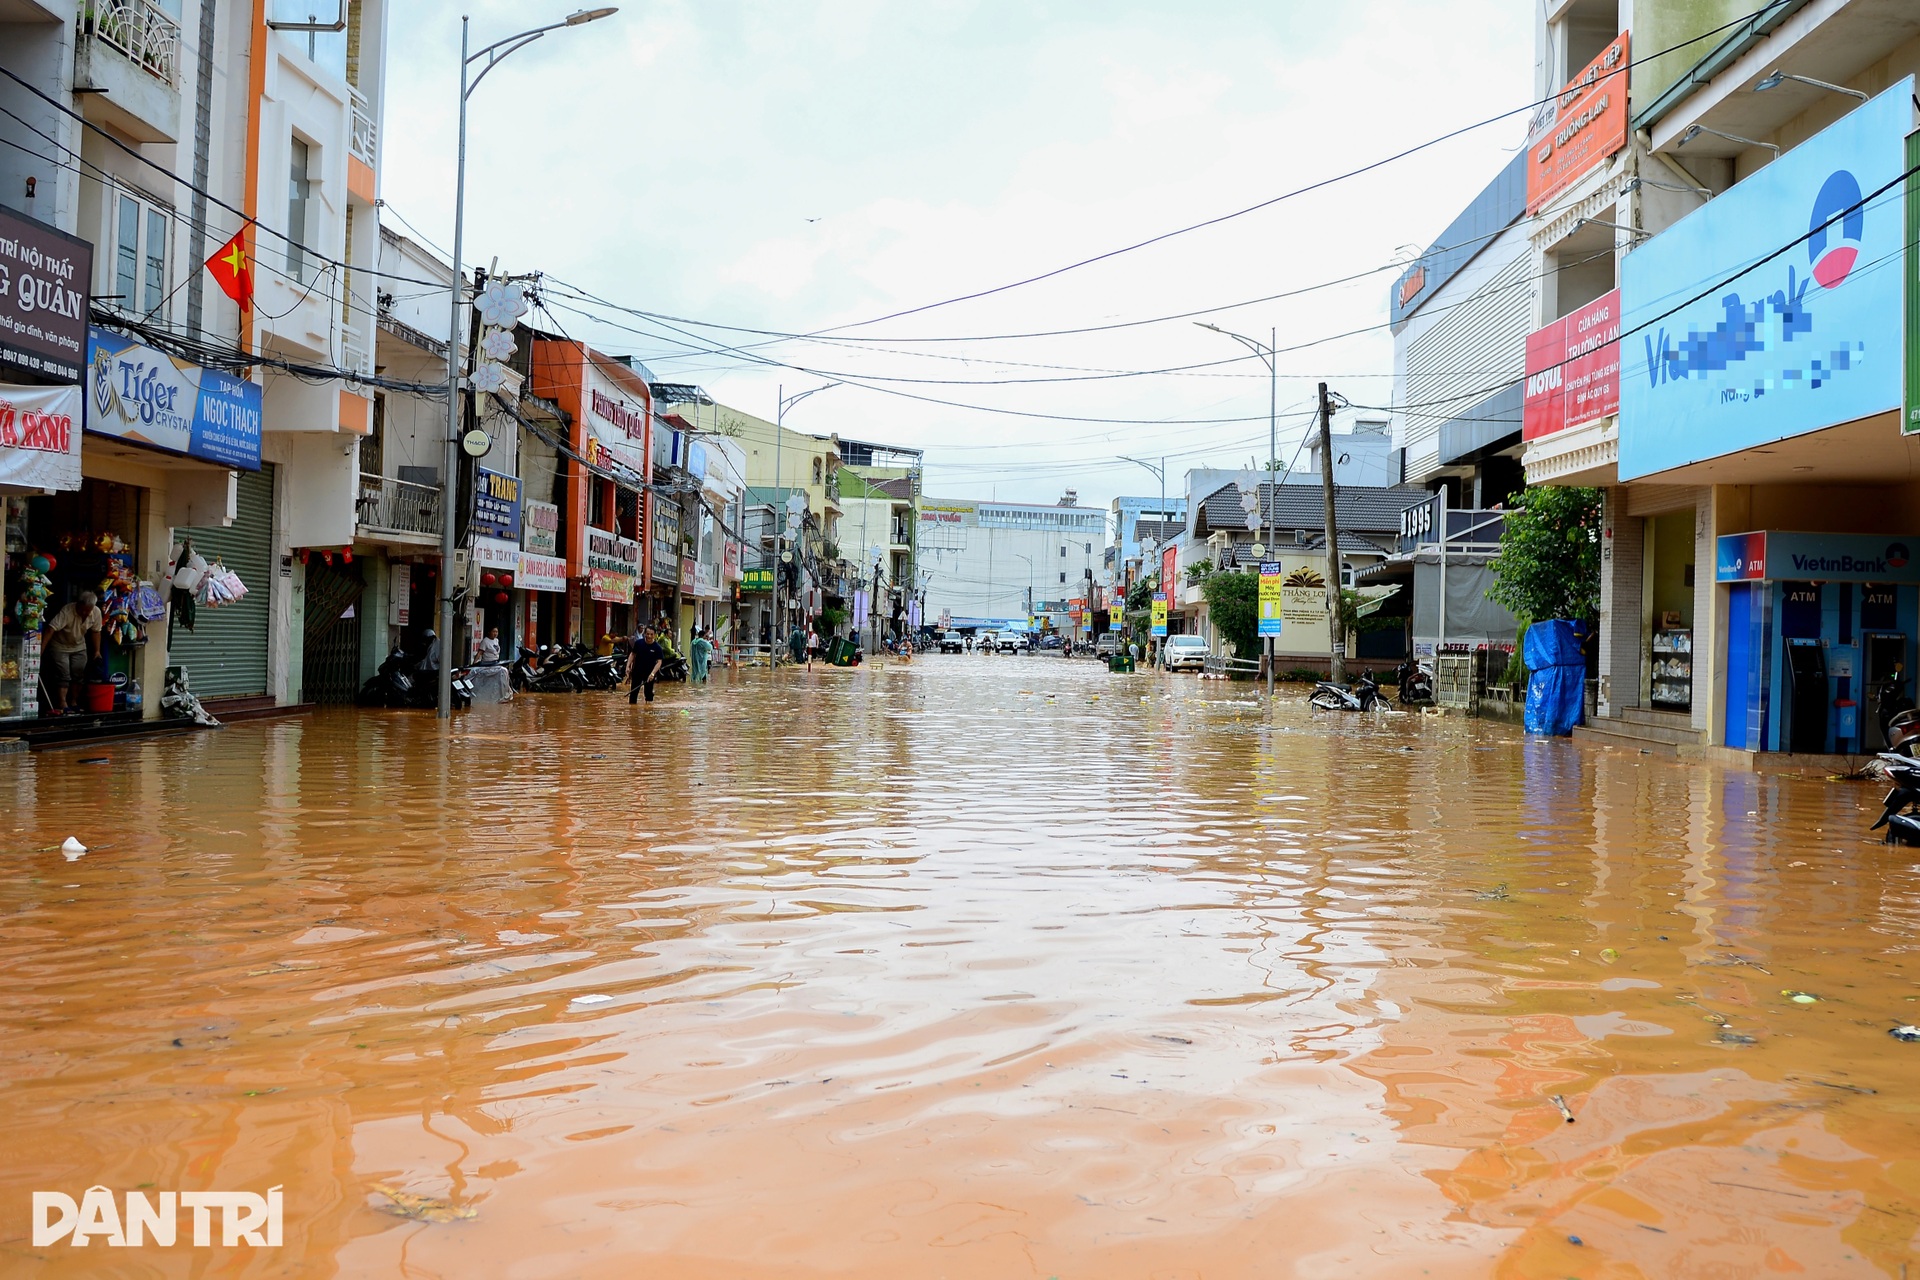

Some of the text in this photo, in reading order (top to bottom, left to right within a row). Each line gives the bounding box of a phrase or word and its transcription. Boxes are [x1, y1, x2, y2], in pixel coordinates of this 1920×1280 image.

[0, 237, 74, 280] TRÍ NỘI THẤT
[18, 273, 82, 320] QUÂN
[1591, 306, 1609, 327] HÀNG
[14, 322, 26, 334] gia
[45, 331, 58, 343] văn
[58, 336, 80, 352] phòng
[118, 360, 193, 433] Tiger CRYSTAL
[1526, 365, 1562, 398] MOTUL
[18, 407, 72, 455] HÀNG
[203, 395, 258, 437] NGỌC THẠCH
[490, 474, 518, 502] TRANG
[1407, 504, 1431, 538] 1995
[1748, 560, 1762, 571] ATM
[1792, 554, 1887, 573] VietinBank
[1790, 592, 1816, 602] ATM
[1868, 594, 1893, 604] ATM
